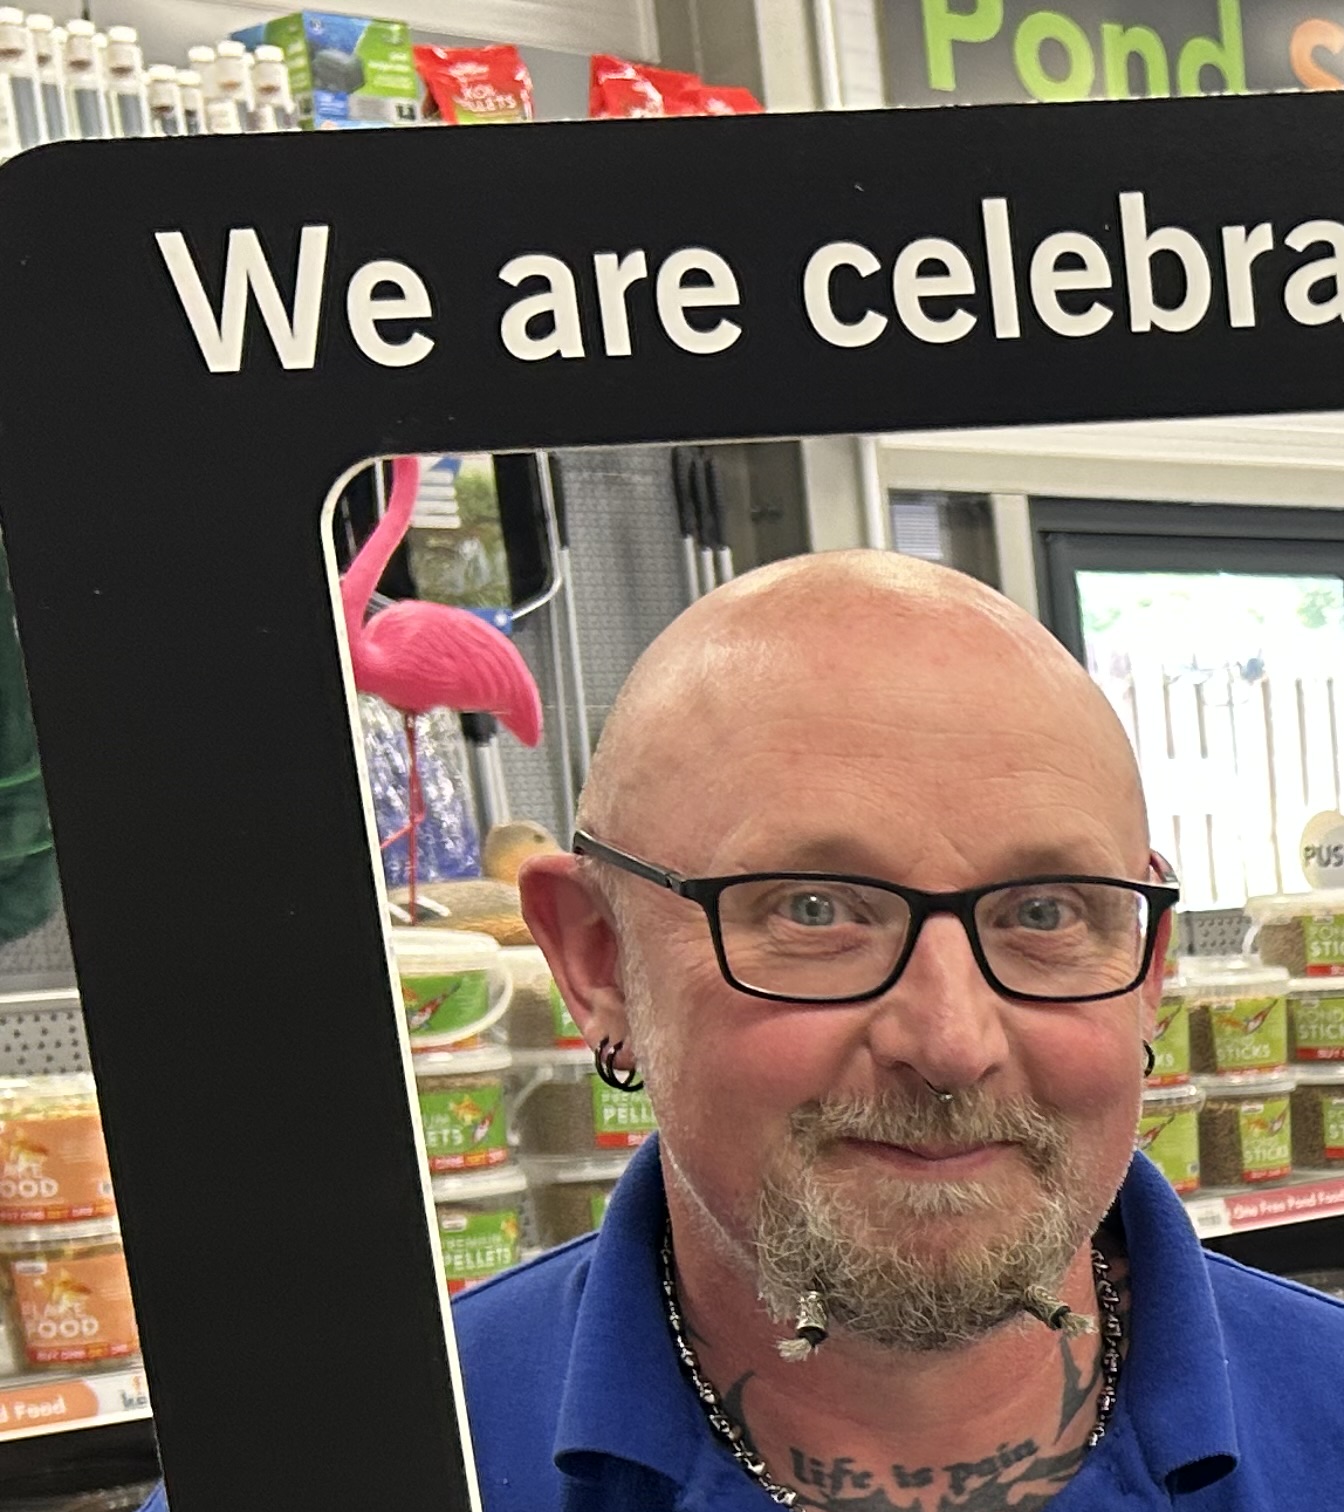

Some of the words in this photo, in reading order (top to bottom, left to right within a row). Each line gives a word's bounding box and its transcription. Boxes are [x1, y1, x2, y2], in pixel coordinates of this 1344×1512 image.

[921, 0, 1246, 104] Pond
[154, 225, 435, 374] We
[498, 244, 743, 362] are
[0, 1178, 58, 1198] OOD
[1232, 1203, 1258, 1221] One
[1260, 1198, 1286, 1216] Free
[1288, 1194, 1316, 1212] Pond
[25, 1318, 99, 1339] FOOD
[14, 1395, 66, 1419] Food
